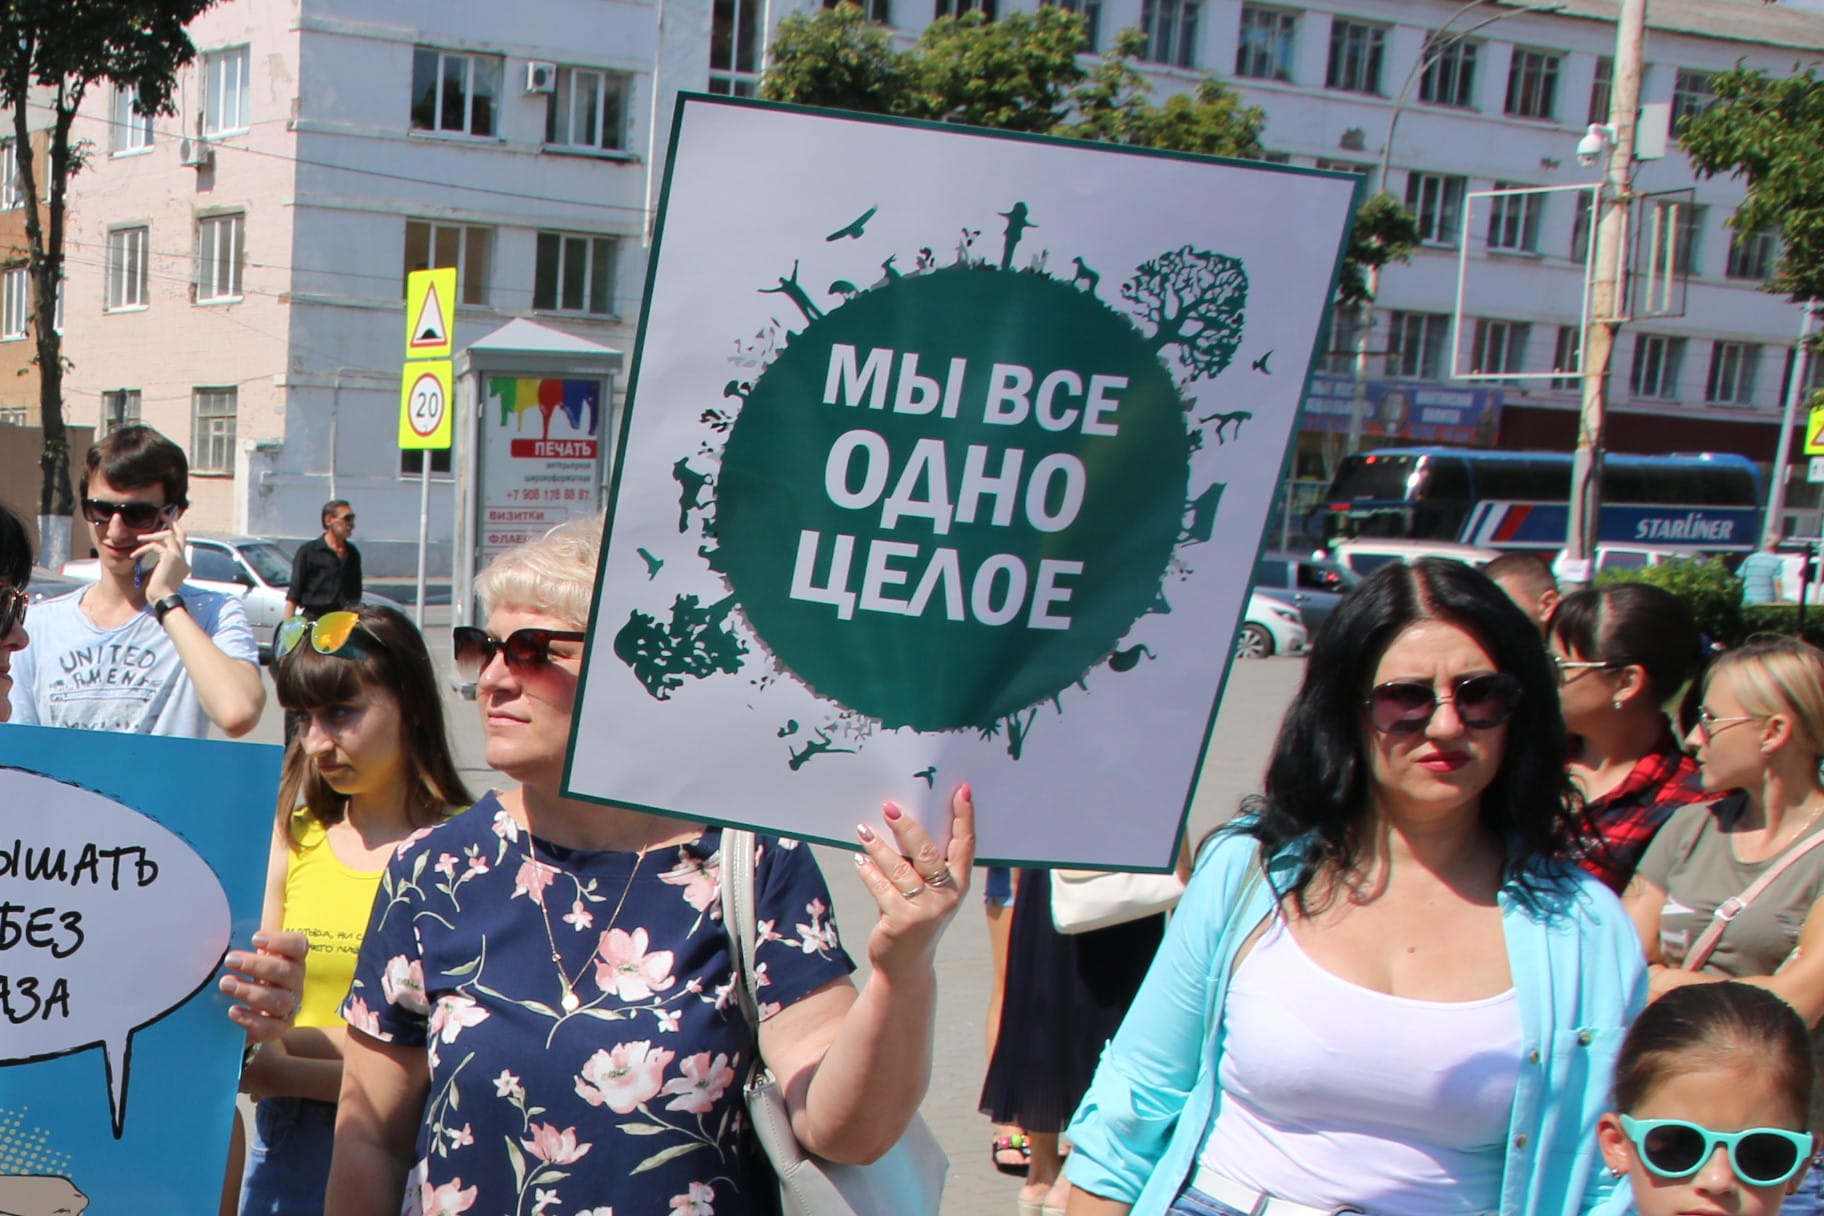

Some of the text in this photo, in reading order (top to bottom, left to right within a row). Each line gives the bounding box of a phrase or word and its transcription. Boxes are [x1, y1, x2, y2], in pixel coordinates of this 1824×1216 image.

[416, 392, 438, 418] 20
[822, 343, 1129, 437] МЫ ВСЕ
[534, 441, 592, 457] ПЕЧАТЬ
[824, 429, 1087, 535] ОДНО
[789, 529, 1084, 630] ЦЕЛОЕ
[59, 644, 156, 672] UNITED
